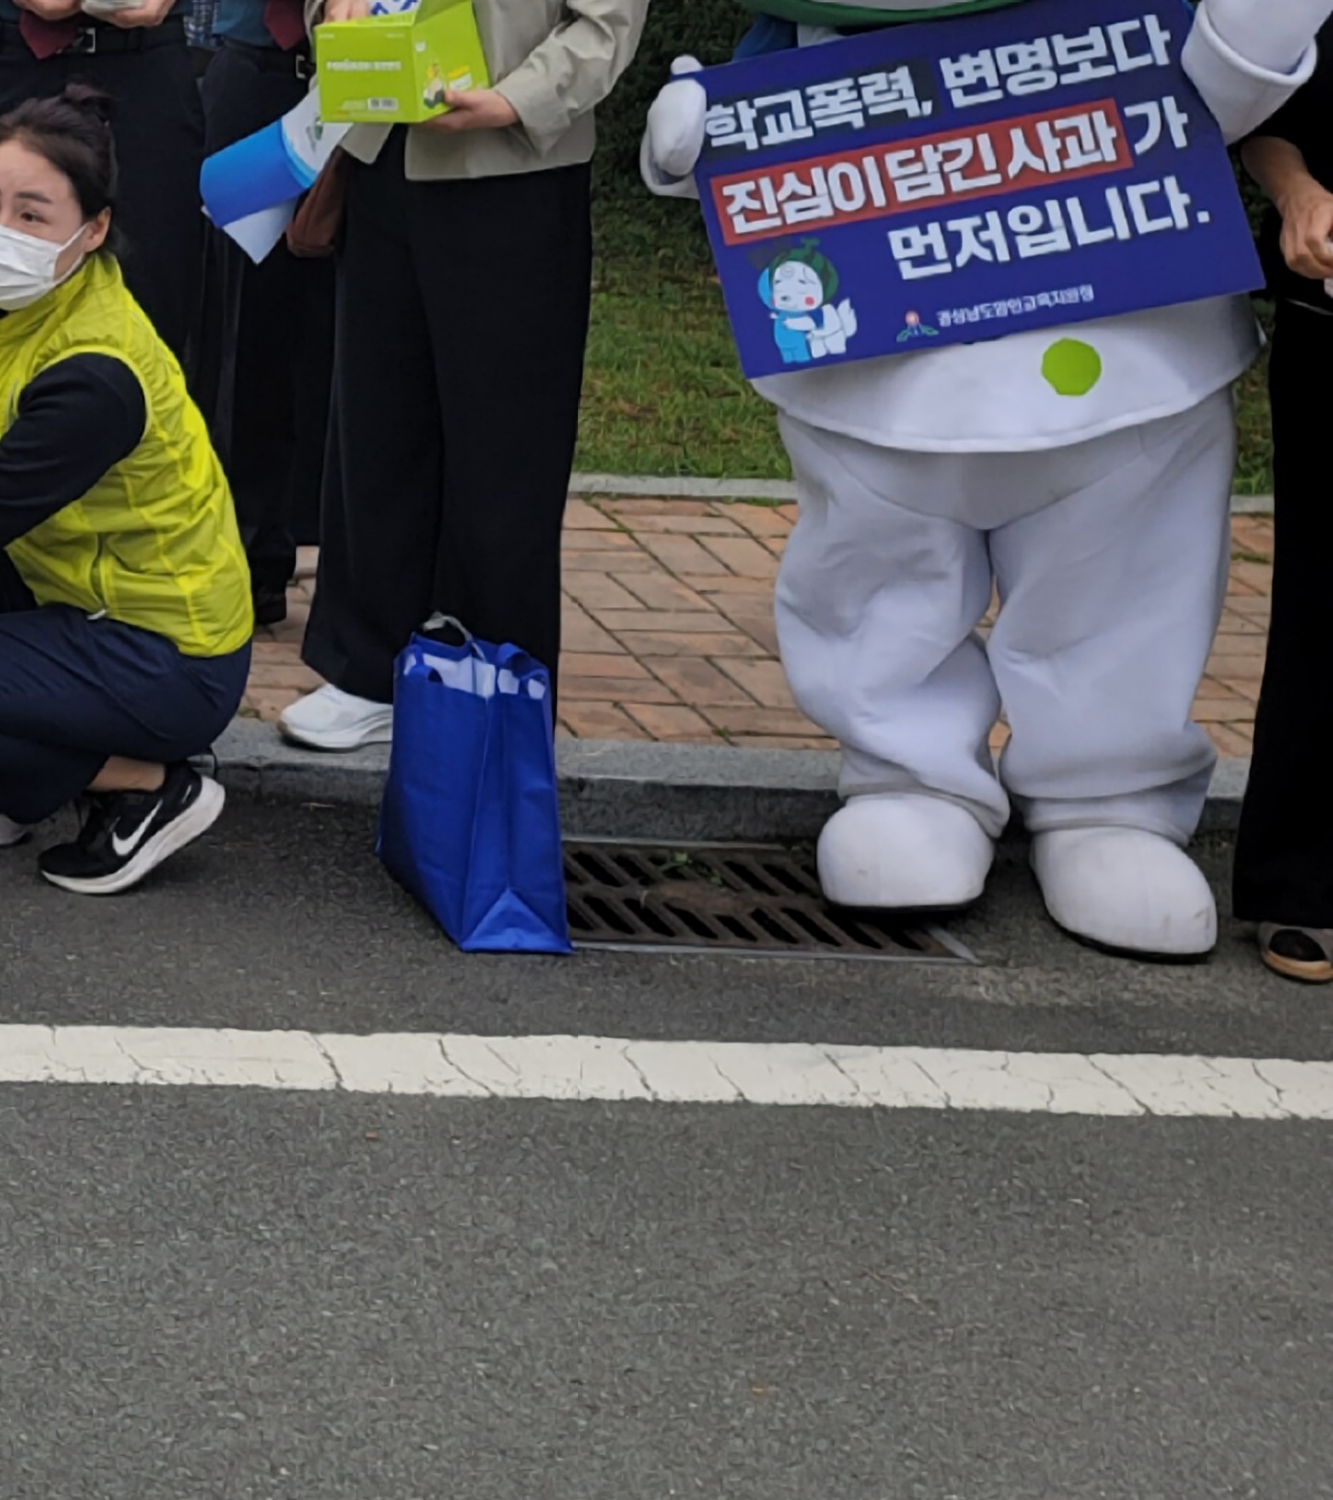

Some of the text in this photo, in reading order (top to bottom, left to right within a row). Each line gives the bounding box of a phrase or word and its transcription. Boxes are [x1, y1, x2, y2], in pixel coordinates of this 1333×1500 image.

[704, 13, 1171, 151] 학교폭력, 변명보다
[886, 175, 1211, 281] 먼저입니다.
